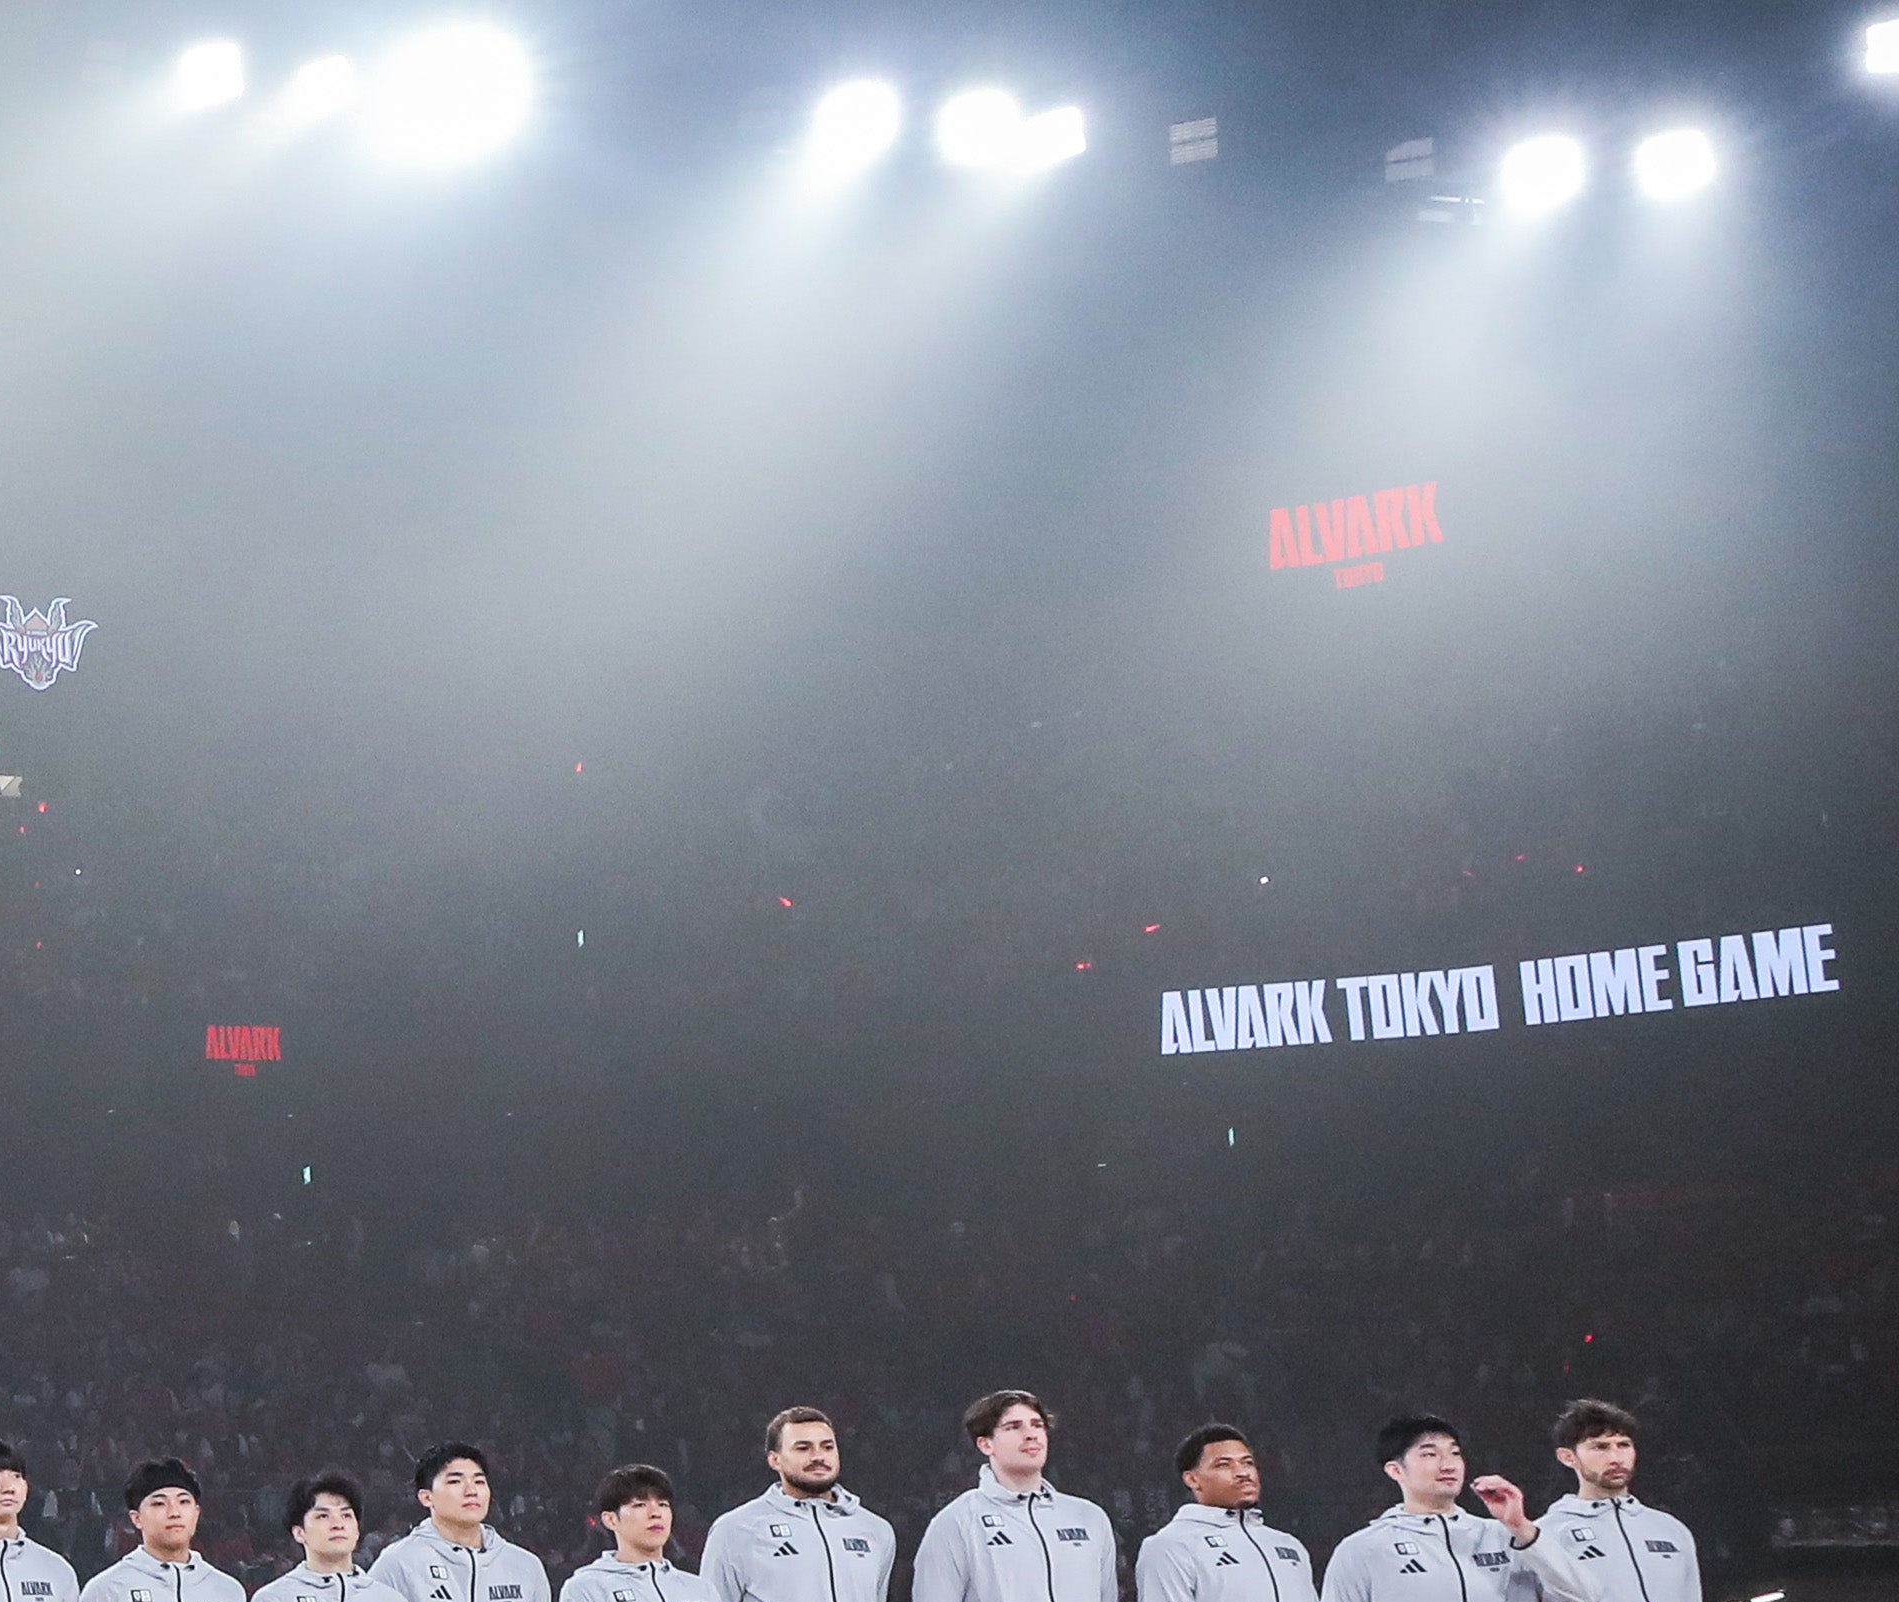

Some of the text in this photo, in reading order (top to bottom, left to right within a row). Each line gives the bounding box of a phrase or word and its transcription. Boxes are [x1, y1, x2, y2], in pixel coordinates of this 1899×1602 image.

[1269, 480, 1445, 570] ALVARK
[1161, 922, 1840, 1055] ALVARK TOKYO HOME GAME
